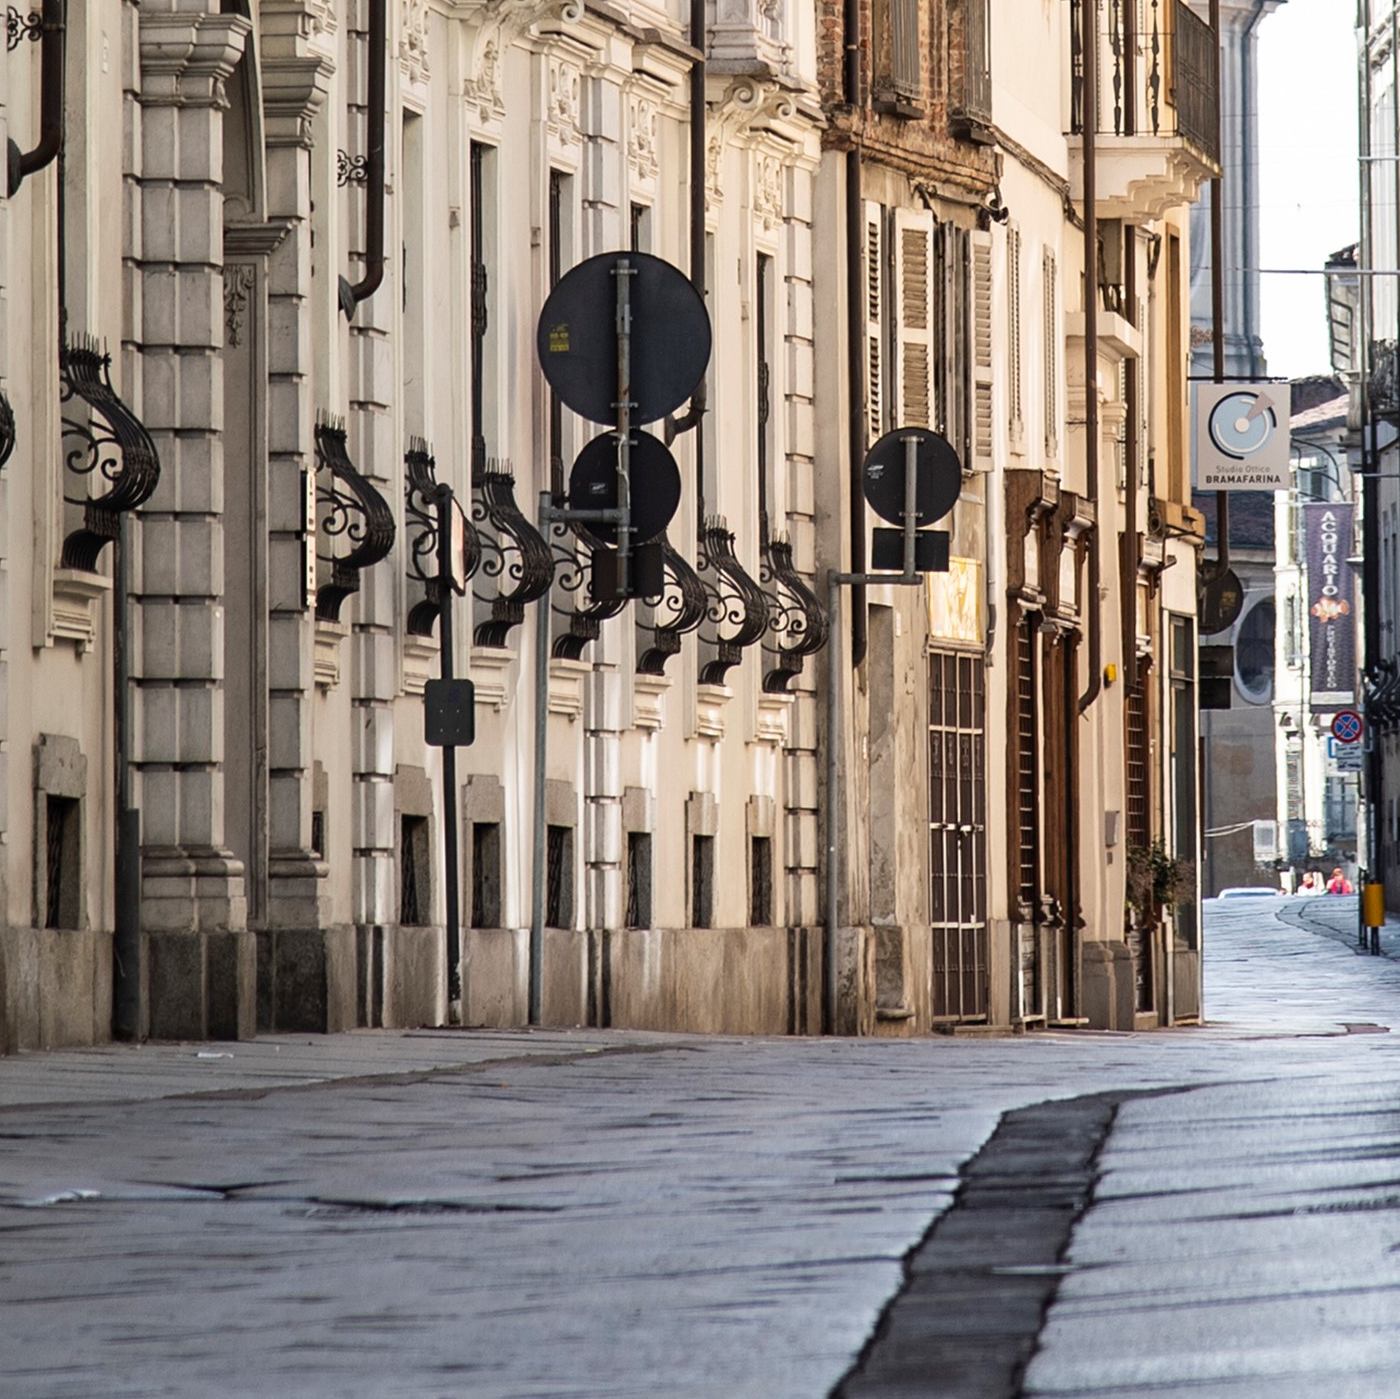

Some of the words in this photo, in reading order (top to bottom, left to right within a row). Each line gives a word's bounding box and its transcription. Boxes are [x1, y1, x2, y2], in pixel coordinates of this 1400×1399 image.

[1216, 465, 1243, 473] Studio
[1245, 465, 1271, 473] Ottico
[1205, 475, 1281, 484] BRAMAFARINA
[1321, 511, 1339, 596] ACQUARIO
